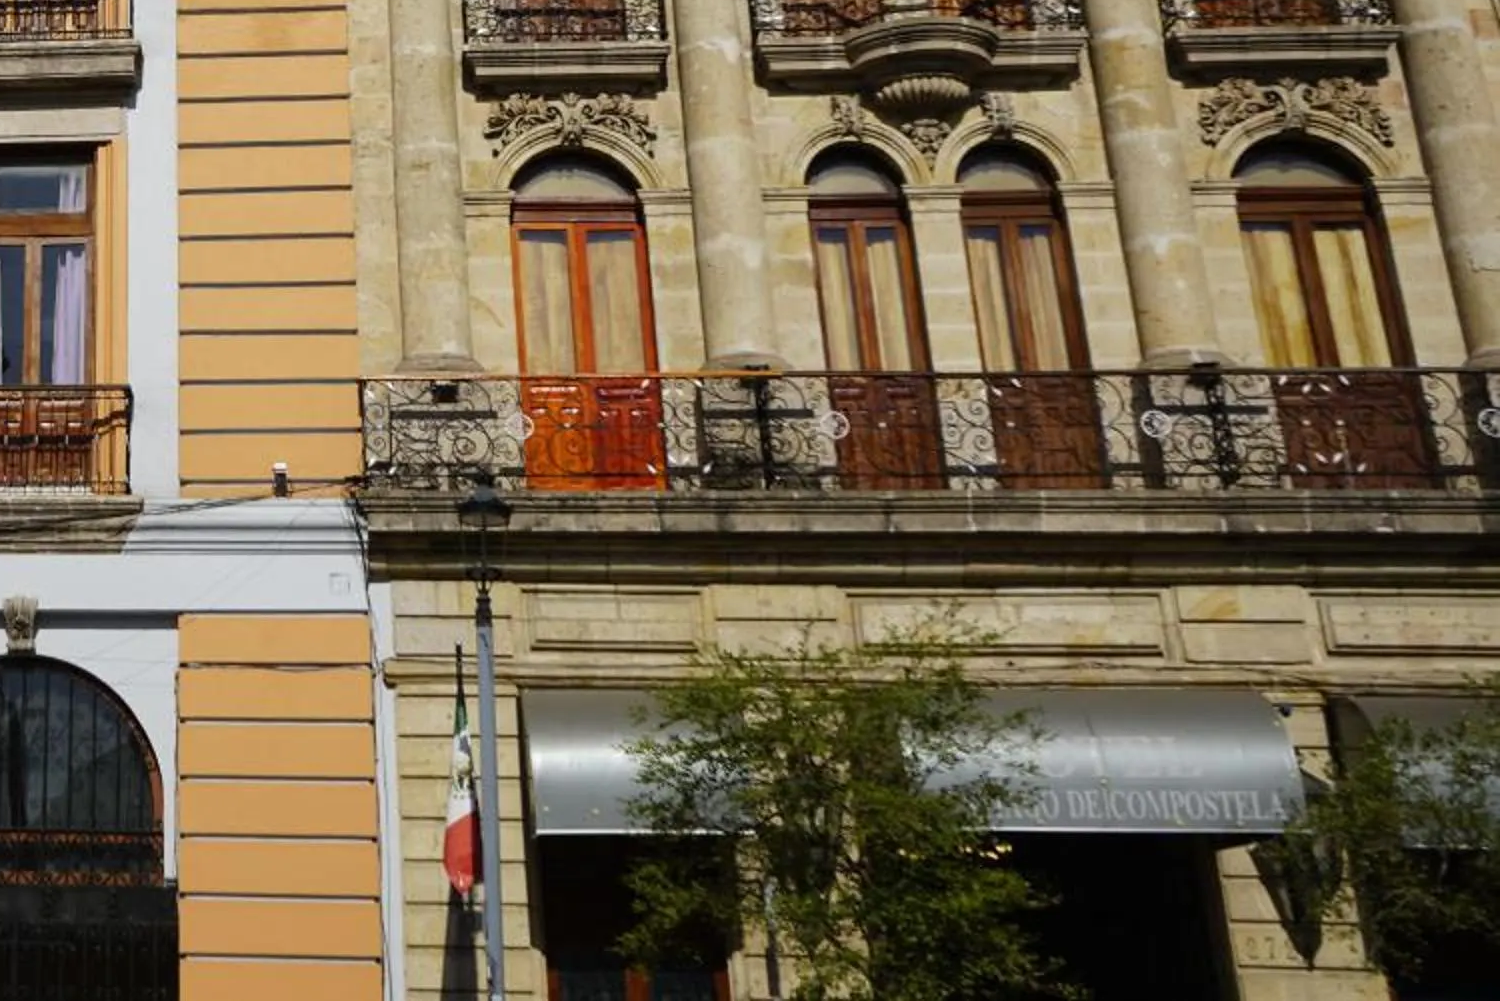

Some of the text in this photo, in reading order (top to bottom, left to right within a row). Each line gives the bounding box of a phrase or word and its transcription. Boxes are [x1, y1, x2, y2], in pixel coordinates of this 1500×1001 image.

[992, 735, 1203, 779] OTEL
[1067, 789, 1105, 821] DE
[1110, 790, 1287, 821] COMPOSTELA
